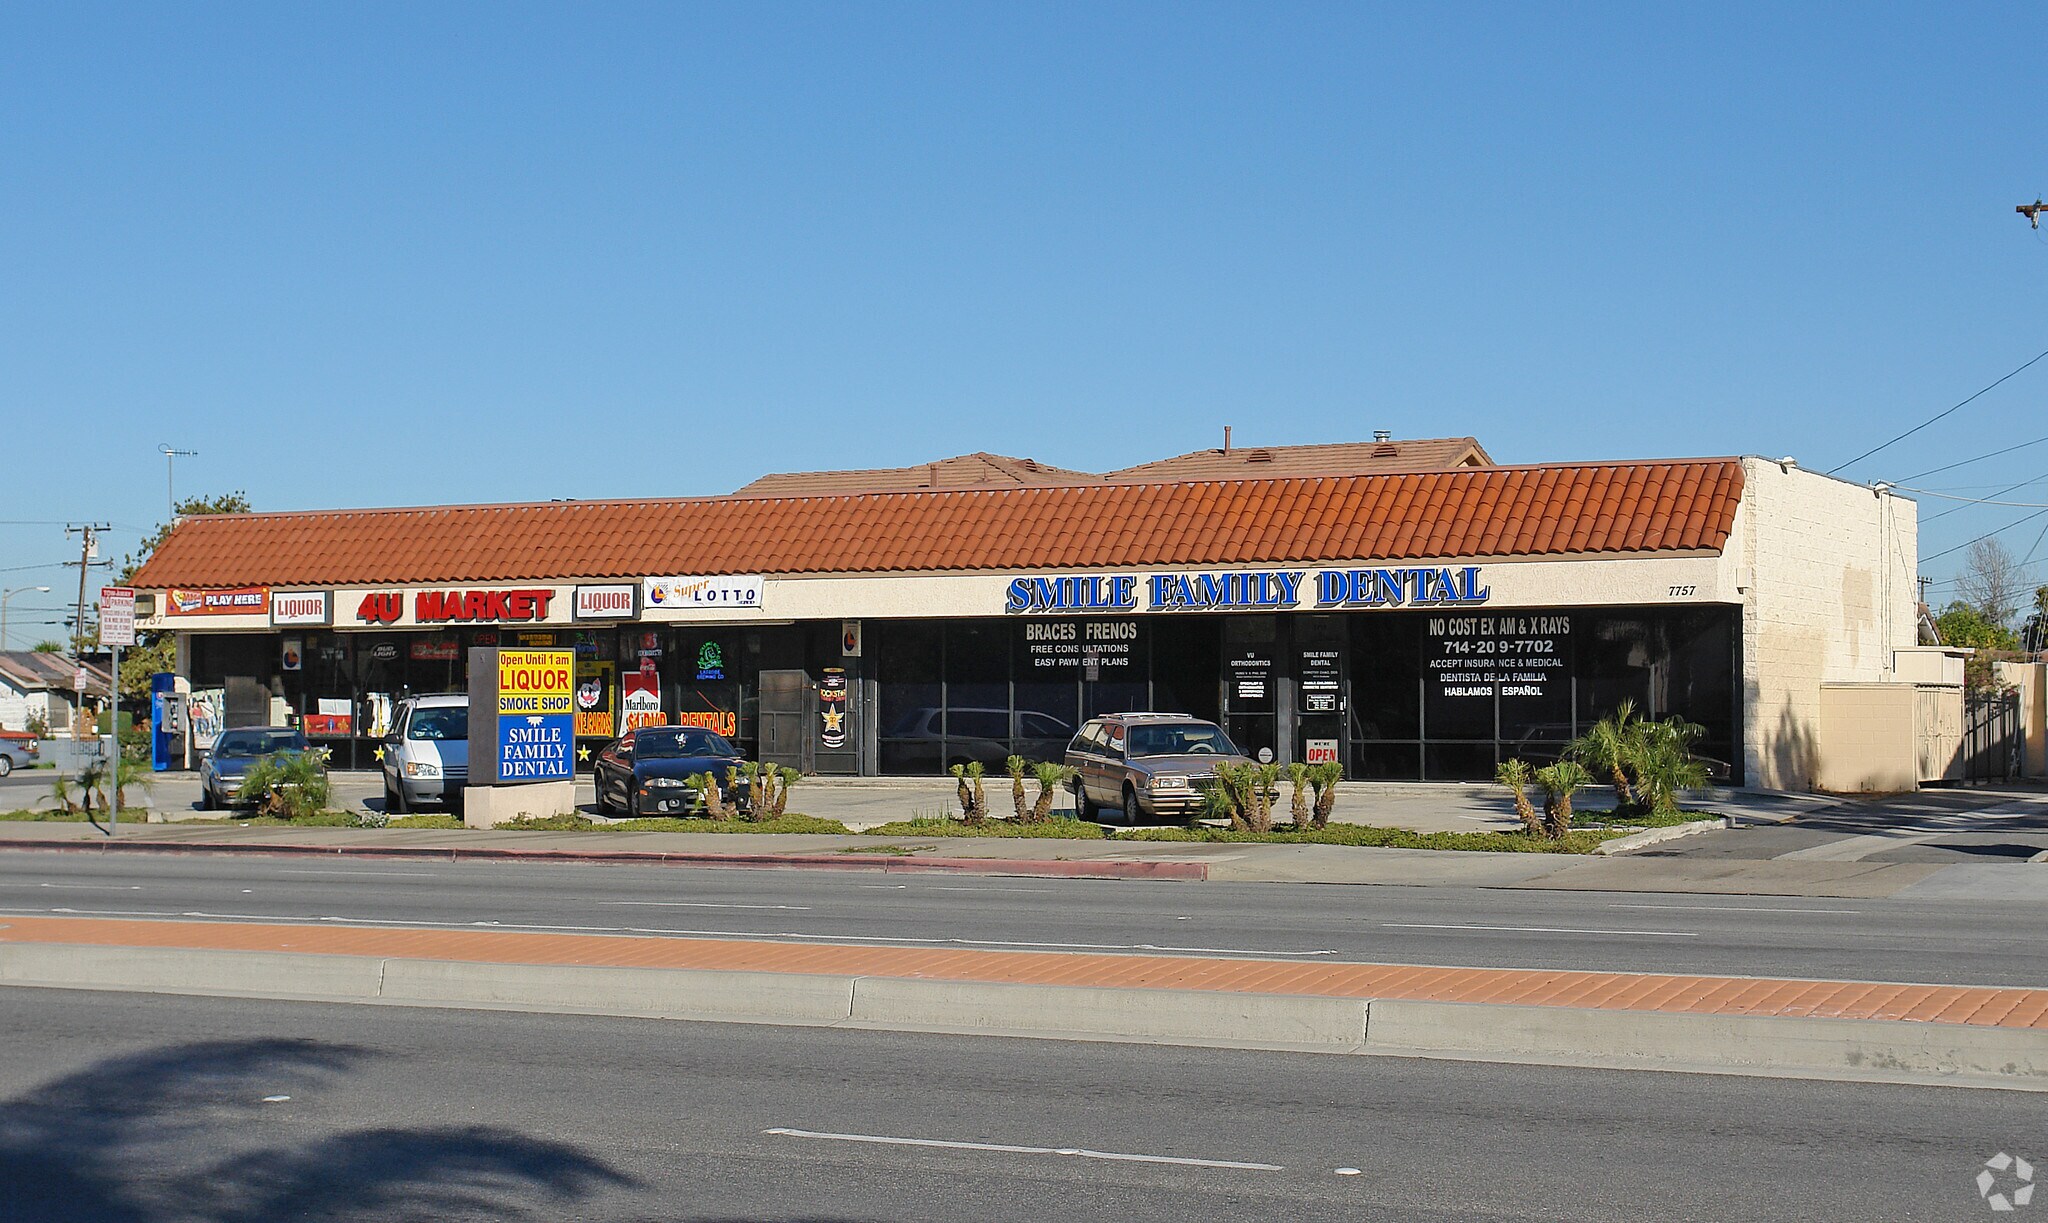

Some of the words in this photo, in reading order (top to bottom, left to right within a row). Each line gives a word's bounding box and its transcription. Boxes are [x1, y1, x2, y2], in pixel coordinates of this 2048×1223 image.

[674, 579, 709, 598] Super
[694, 589, 755, 602] LOTTO
[1006, 576, 1138, 613] SMILE
[1147, 572, 1305, 612] FAMILY
[1315, 567, 1490, 608] DENTAL
[1669, 585, 1696, 596] 7757
[205, 595, 232, 606] PLAY
[234, 594, 262, 605] HERE
[357, 592, 403, 624] 4U
[415, 589, 555, 623] MARKET
[580, 592, 631, 613] LIQUOR
[277, 600, 323, 619] LIQUOR
[1026, 623, 1076, 640] BRACES
[1086, 622, 1137, 640] FRENOS
[1429, 618, 1445, 636] NO
[1448, 618, 1478, 636] COST
[1518, 618, 1527, 635] &
[1540, 616, 1570, 634] RAYS
[1030, 645, 1053, 653] FREE
[500, 653, 523, 667] Open
[526, 653, 547, 665] Until
[556, 656, 570, 665] am
[1034, 659, 1056, 667] EASY
[1101, 658, 1129, 666] PLANS
[1429, 659, 1463, 668] ACCEPT
[1517, 659, 1524, 667] &
[1525, 658, 1563, 667] MEDICAL
[500, 669, 569, 691] LIQUOR
[1440, 673, 1482, 682] DENTISTA
[1483, 673, 1496, 682] DE
[1498, 673, 1510, 682] LA
[1512, 672, 1547, 682] FAMILIA
[1444, 687, 1493, 696] HABLAMOS
[1502, 685, 1543, 696] ESPAÑOL
[500, 697, 538, 710] SMOKE
[542, 697, 570, 710] SHOP
[625, 696, 659, 711] Marlboro
[680, 711, 736, 737] RENTALS
[509, 727, 562, 743] SMILE
[503, 743, 567, 760] FAMILY
[1308, 748, 1337, 761] OPEN
[502, 760, 569, 777] DENTAL
